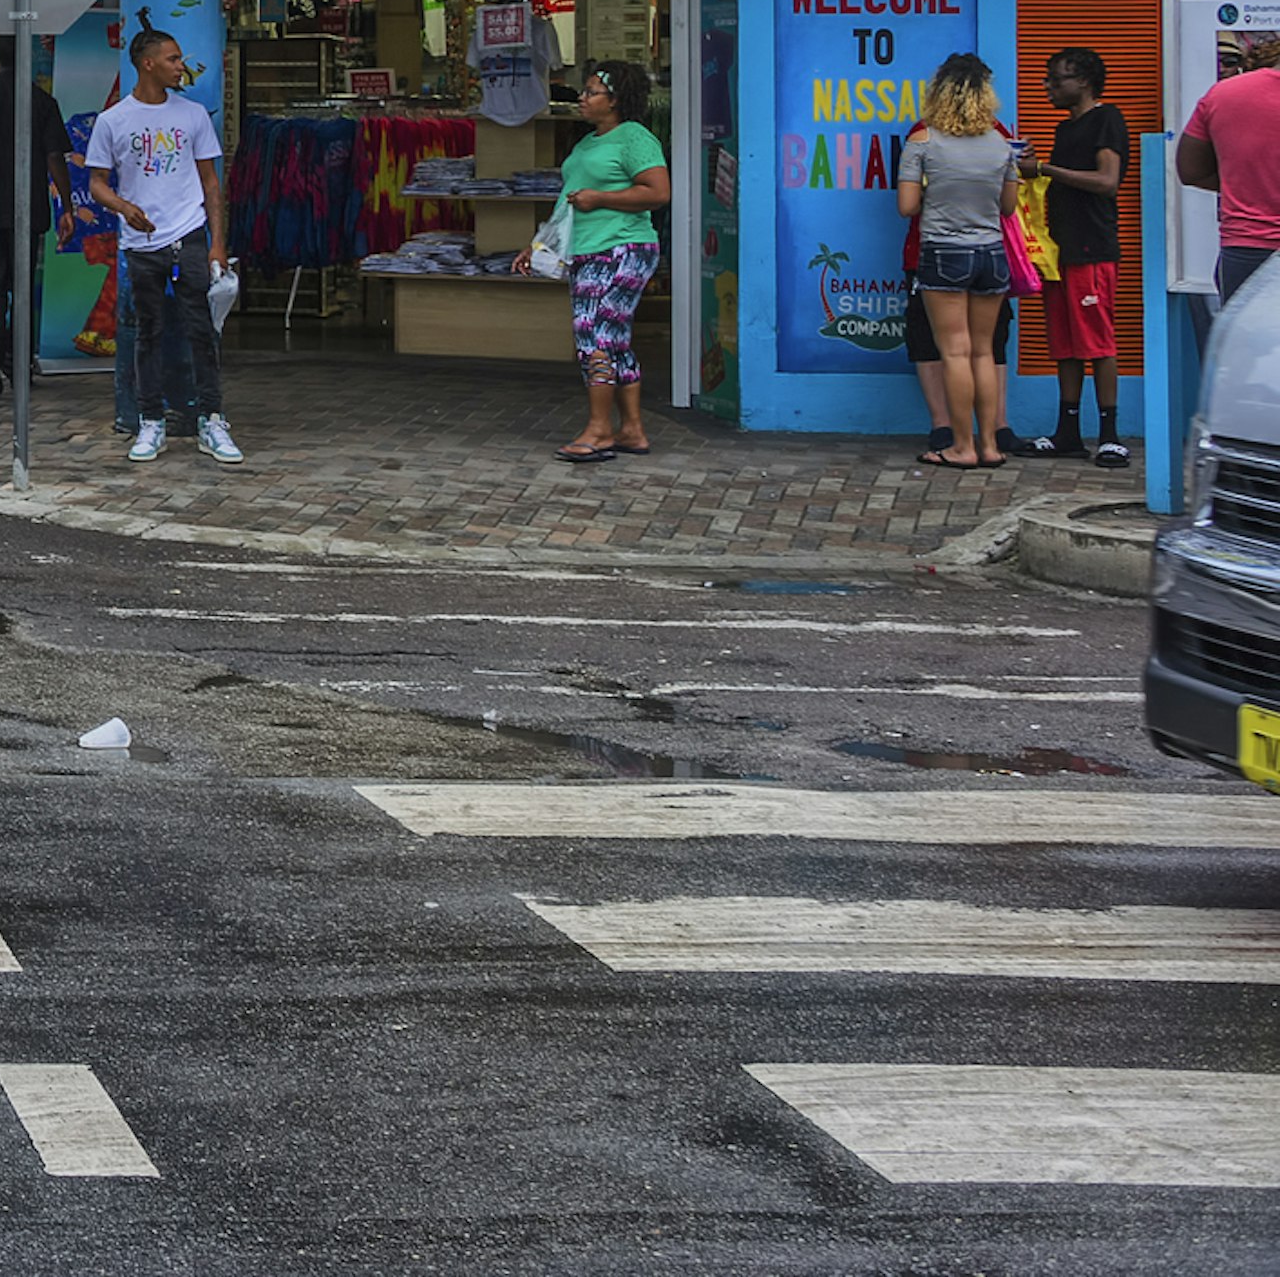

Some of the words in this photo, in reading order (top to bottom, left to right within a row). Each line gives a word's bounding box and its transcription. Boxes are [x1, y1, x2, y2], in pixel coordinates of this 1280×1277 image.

[853, 28, 895, 66] TO
[131, 128, 183, 160] CHASE
[831, 277, 908, 295] BAHAMA
[837, 319, 907, 338] COMPAN
